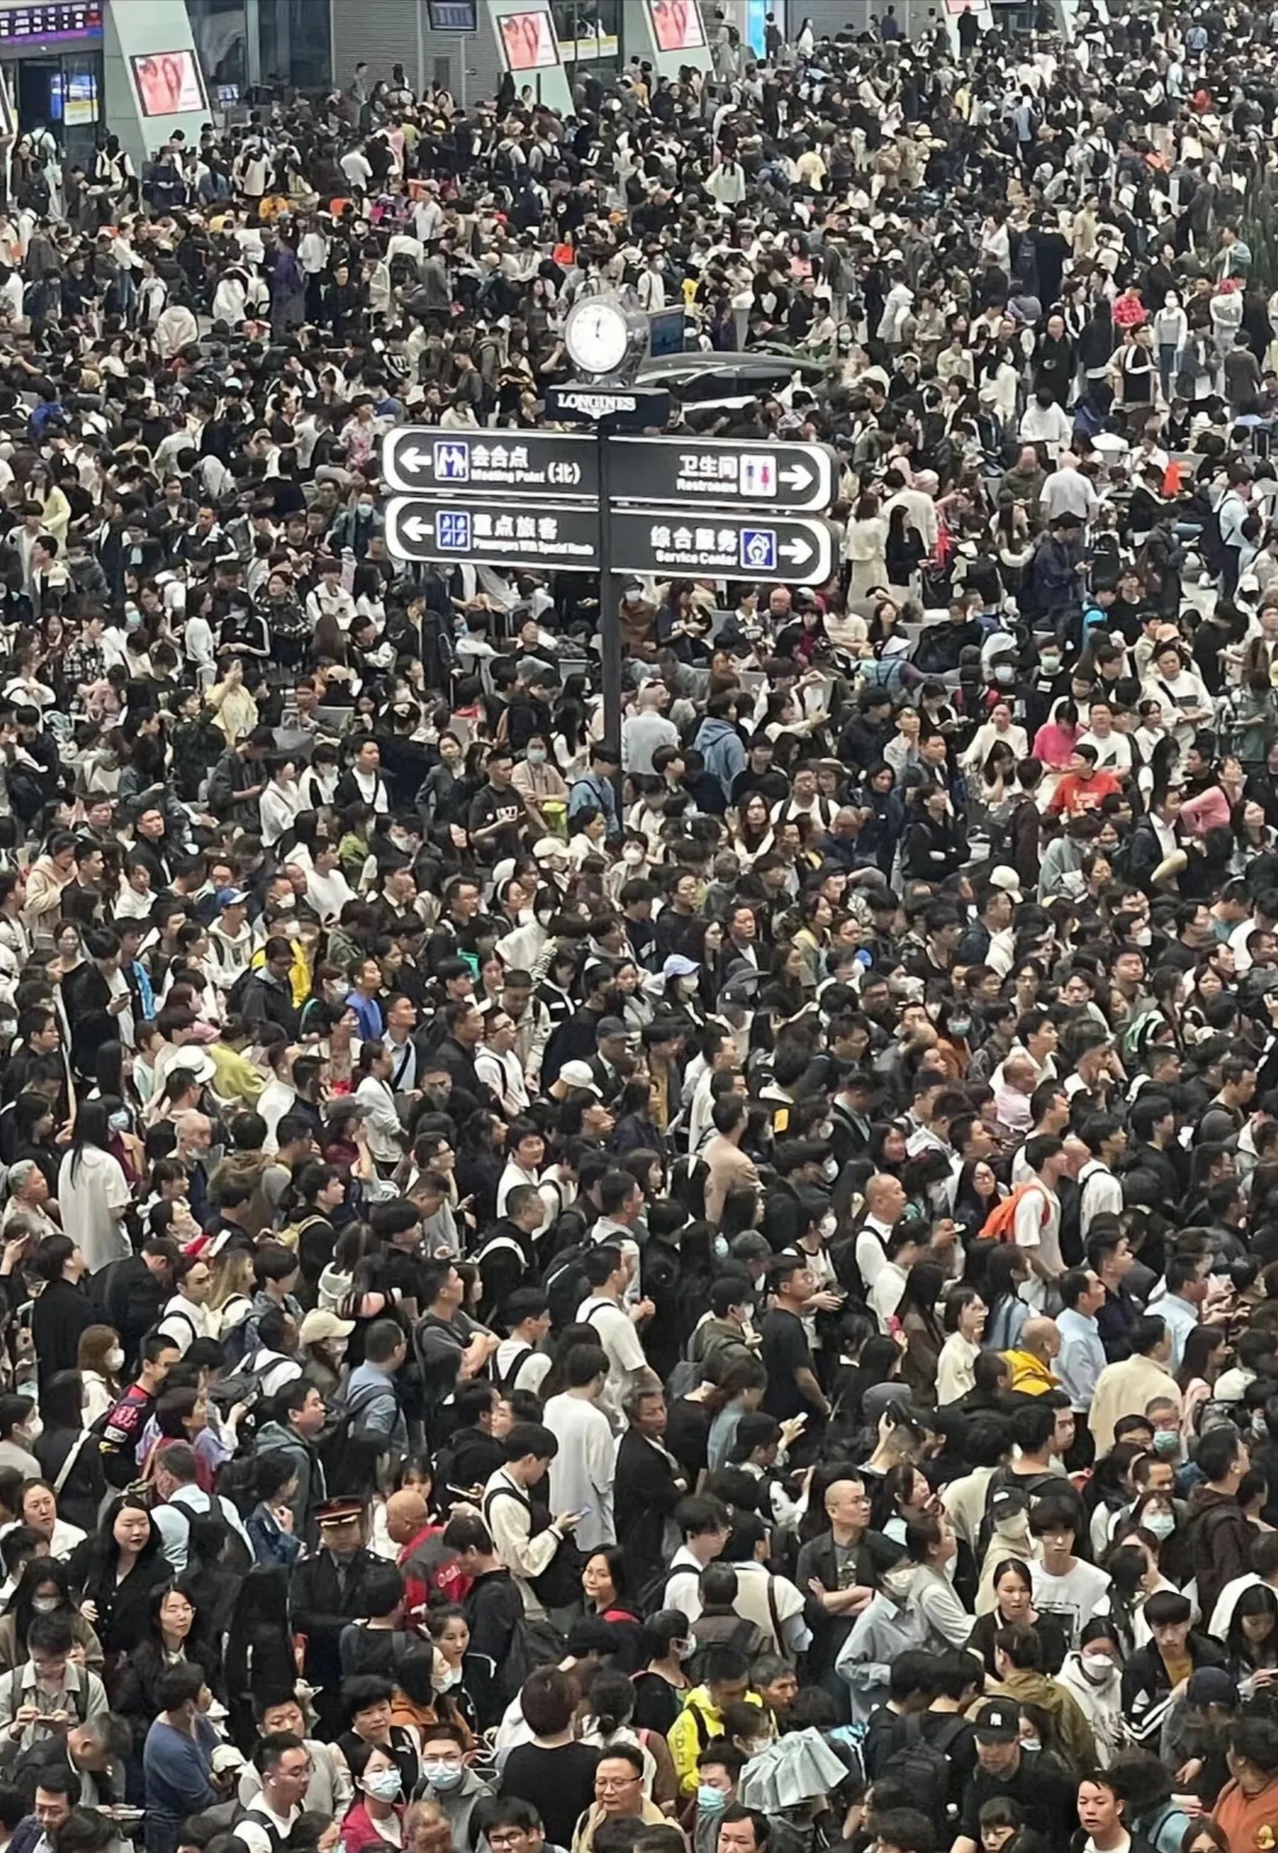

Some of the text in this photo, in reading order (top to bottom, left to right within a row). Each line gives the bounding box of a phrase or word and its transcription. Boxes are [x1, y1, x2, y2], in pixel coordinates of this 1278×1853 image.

[557, 393, 637, 411] LONGINES
[471, 444, 529, 468] 会合点
[678, 454, 739, 479] 卫生间
[515, 470, 545, 483] Point
[472, 513, 559, 540] 重点旅客
[650, 525, 739, 552] 综合服务
[656, 550, 738, 566] Service Center
